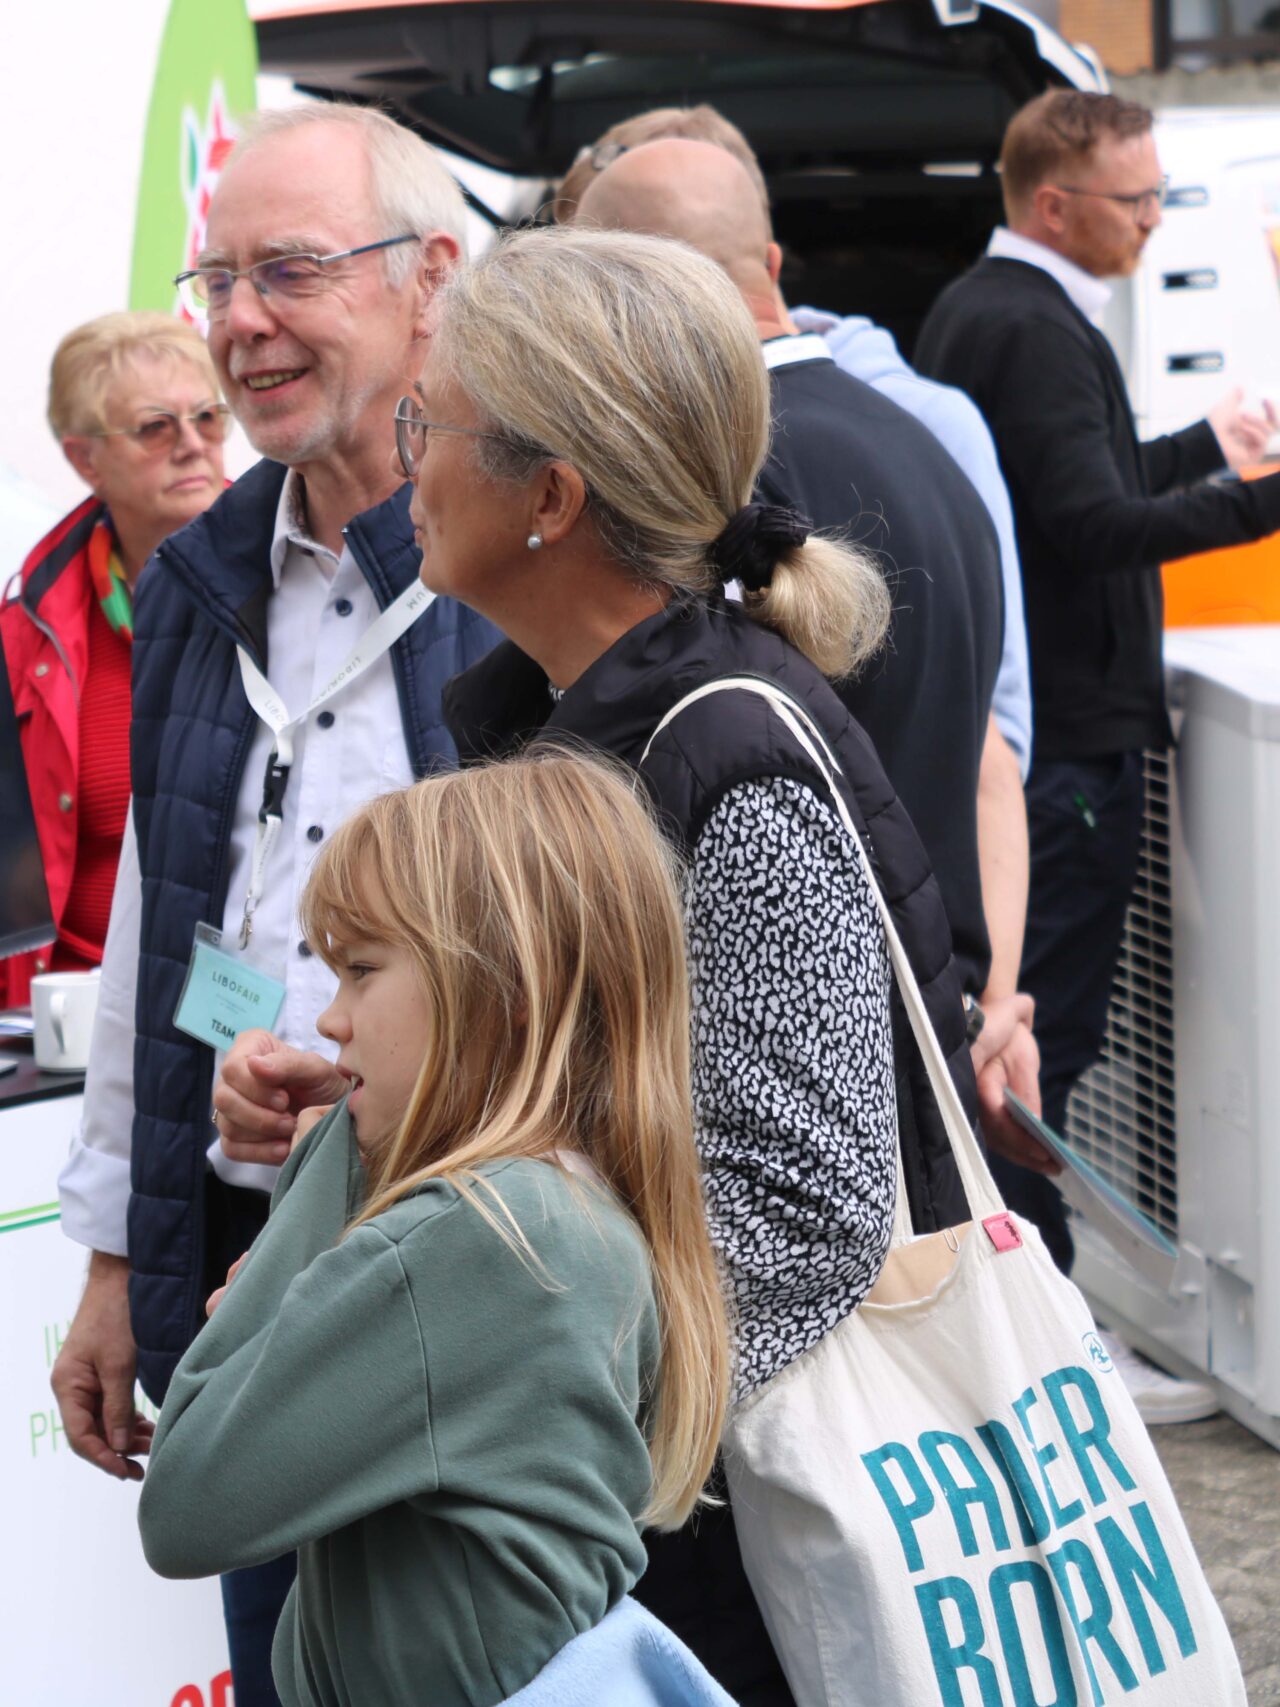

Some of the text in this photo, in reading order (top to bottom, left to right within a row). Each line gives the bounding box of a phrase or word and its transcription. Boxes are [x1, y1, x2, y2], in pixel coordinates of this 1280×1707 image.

[212, 971, 260, 1005] LIBOFAIR
[211, 1019, 236, 1040] TEAM
[859, 1365, 1138, 1574] PADER
